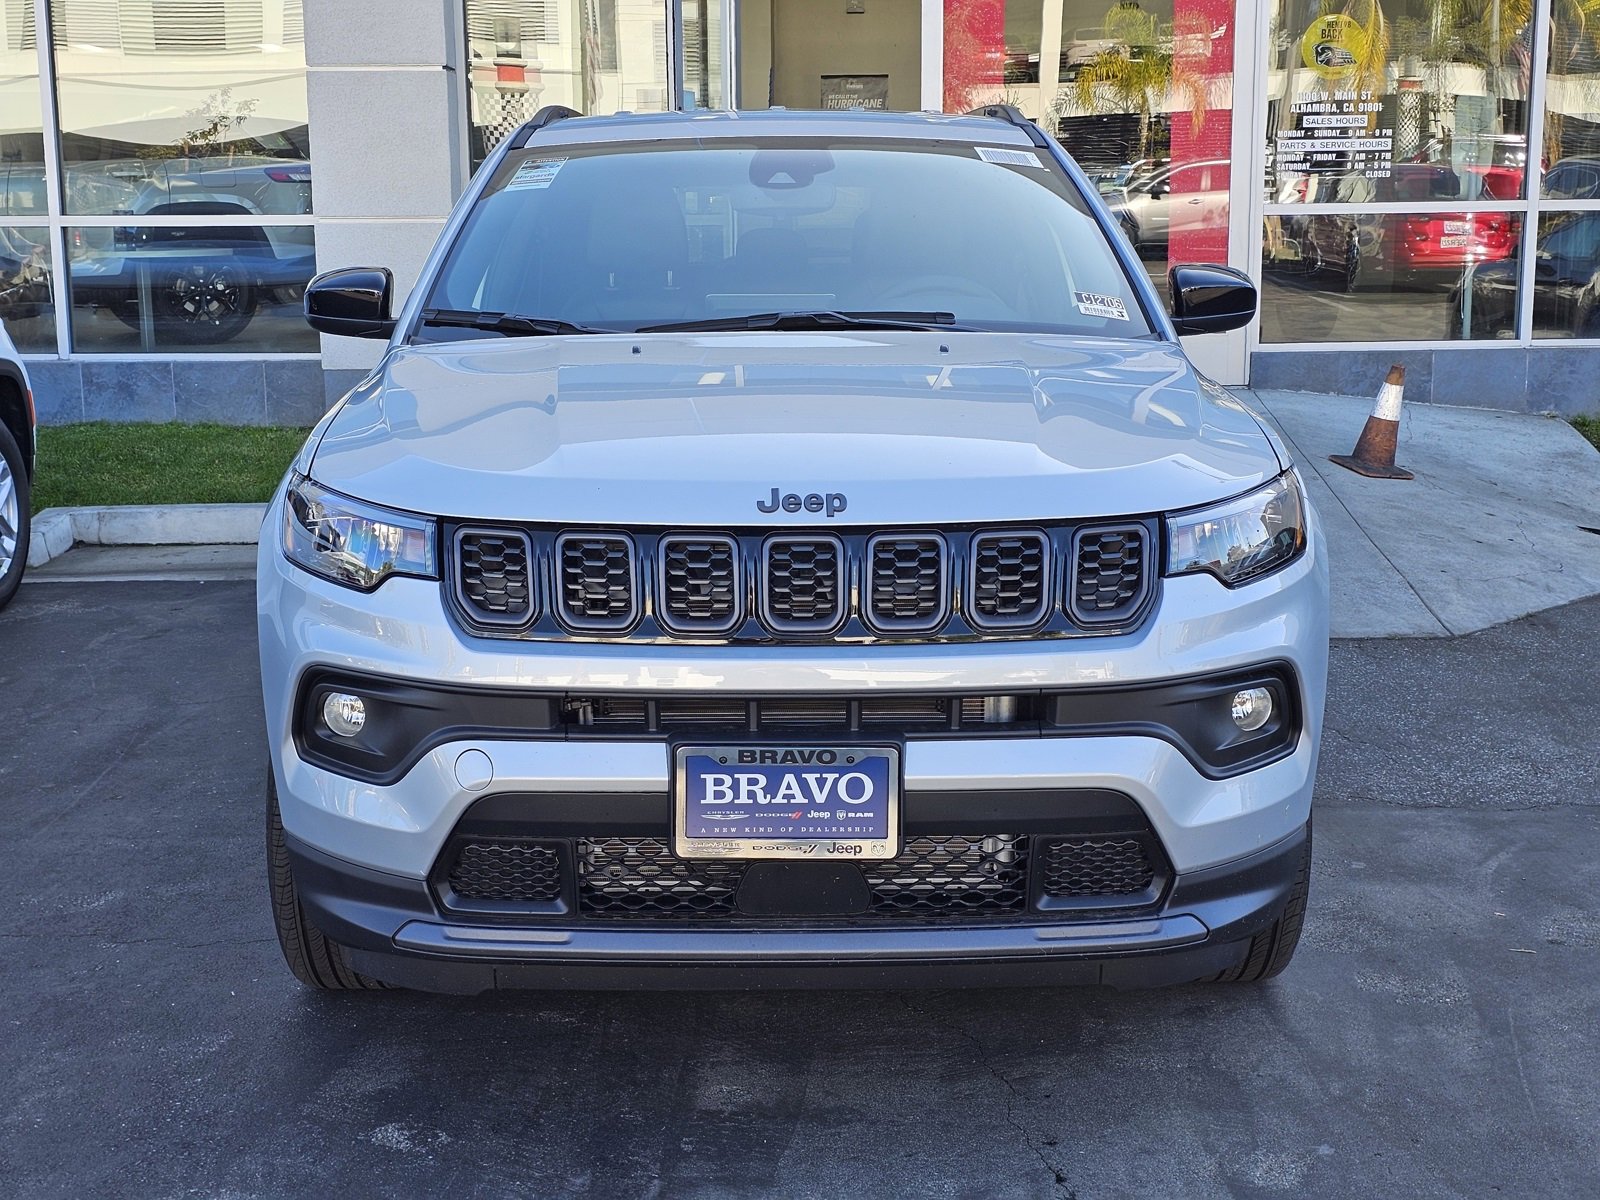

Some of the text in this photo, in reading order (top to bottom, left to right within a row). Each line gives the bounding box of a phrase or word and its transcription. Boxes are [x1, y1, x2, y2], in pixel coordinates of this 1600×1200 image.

[1321, 28, 1343, 39] BACK
[1335, 91, 1357, 100] MAIN
[1361, 90, 1375, 100] ST.
[828, 99, 882, 109] HURRICANE
[1290, 103, 1340, 113] ALHAMBRA,
[1343, 103, 1355, 112] CA
[1305, 117, 1366, 125] SALES HOURS
[1277, 129, 1305, 138] MONDAY
[1314, 129, 1341, 137] SUNDAY
[1355, 129, 1366, 137] AM
[1375, 129, 1380, 137] 9
[1320, 141, 1356, 149] SERVICE
[1359, 140, 1389, 148] HOURS
[1276, 153, 1304, 162] MONDAY
[1313, 153, 1337, 161] FRIDAY
[1375, 152, 1380, 160] 7
[1381, 152, 1392, 160] PM
[1276, 162, 1311, 171] SATURDAY
[1380, 161, 1391, 169] PM
[1365, 170, 1391, 178] CLOSED
[756, 487, 848, 518] Jeep
[737, 750, 838, 765] BRAVO
[700, 772, 874, 805] BRAVO
[807, 810, 831, 819] Jeep
[826, 842, 863, 856] Jeep
